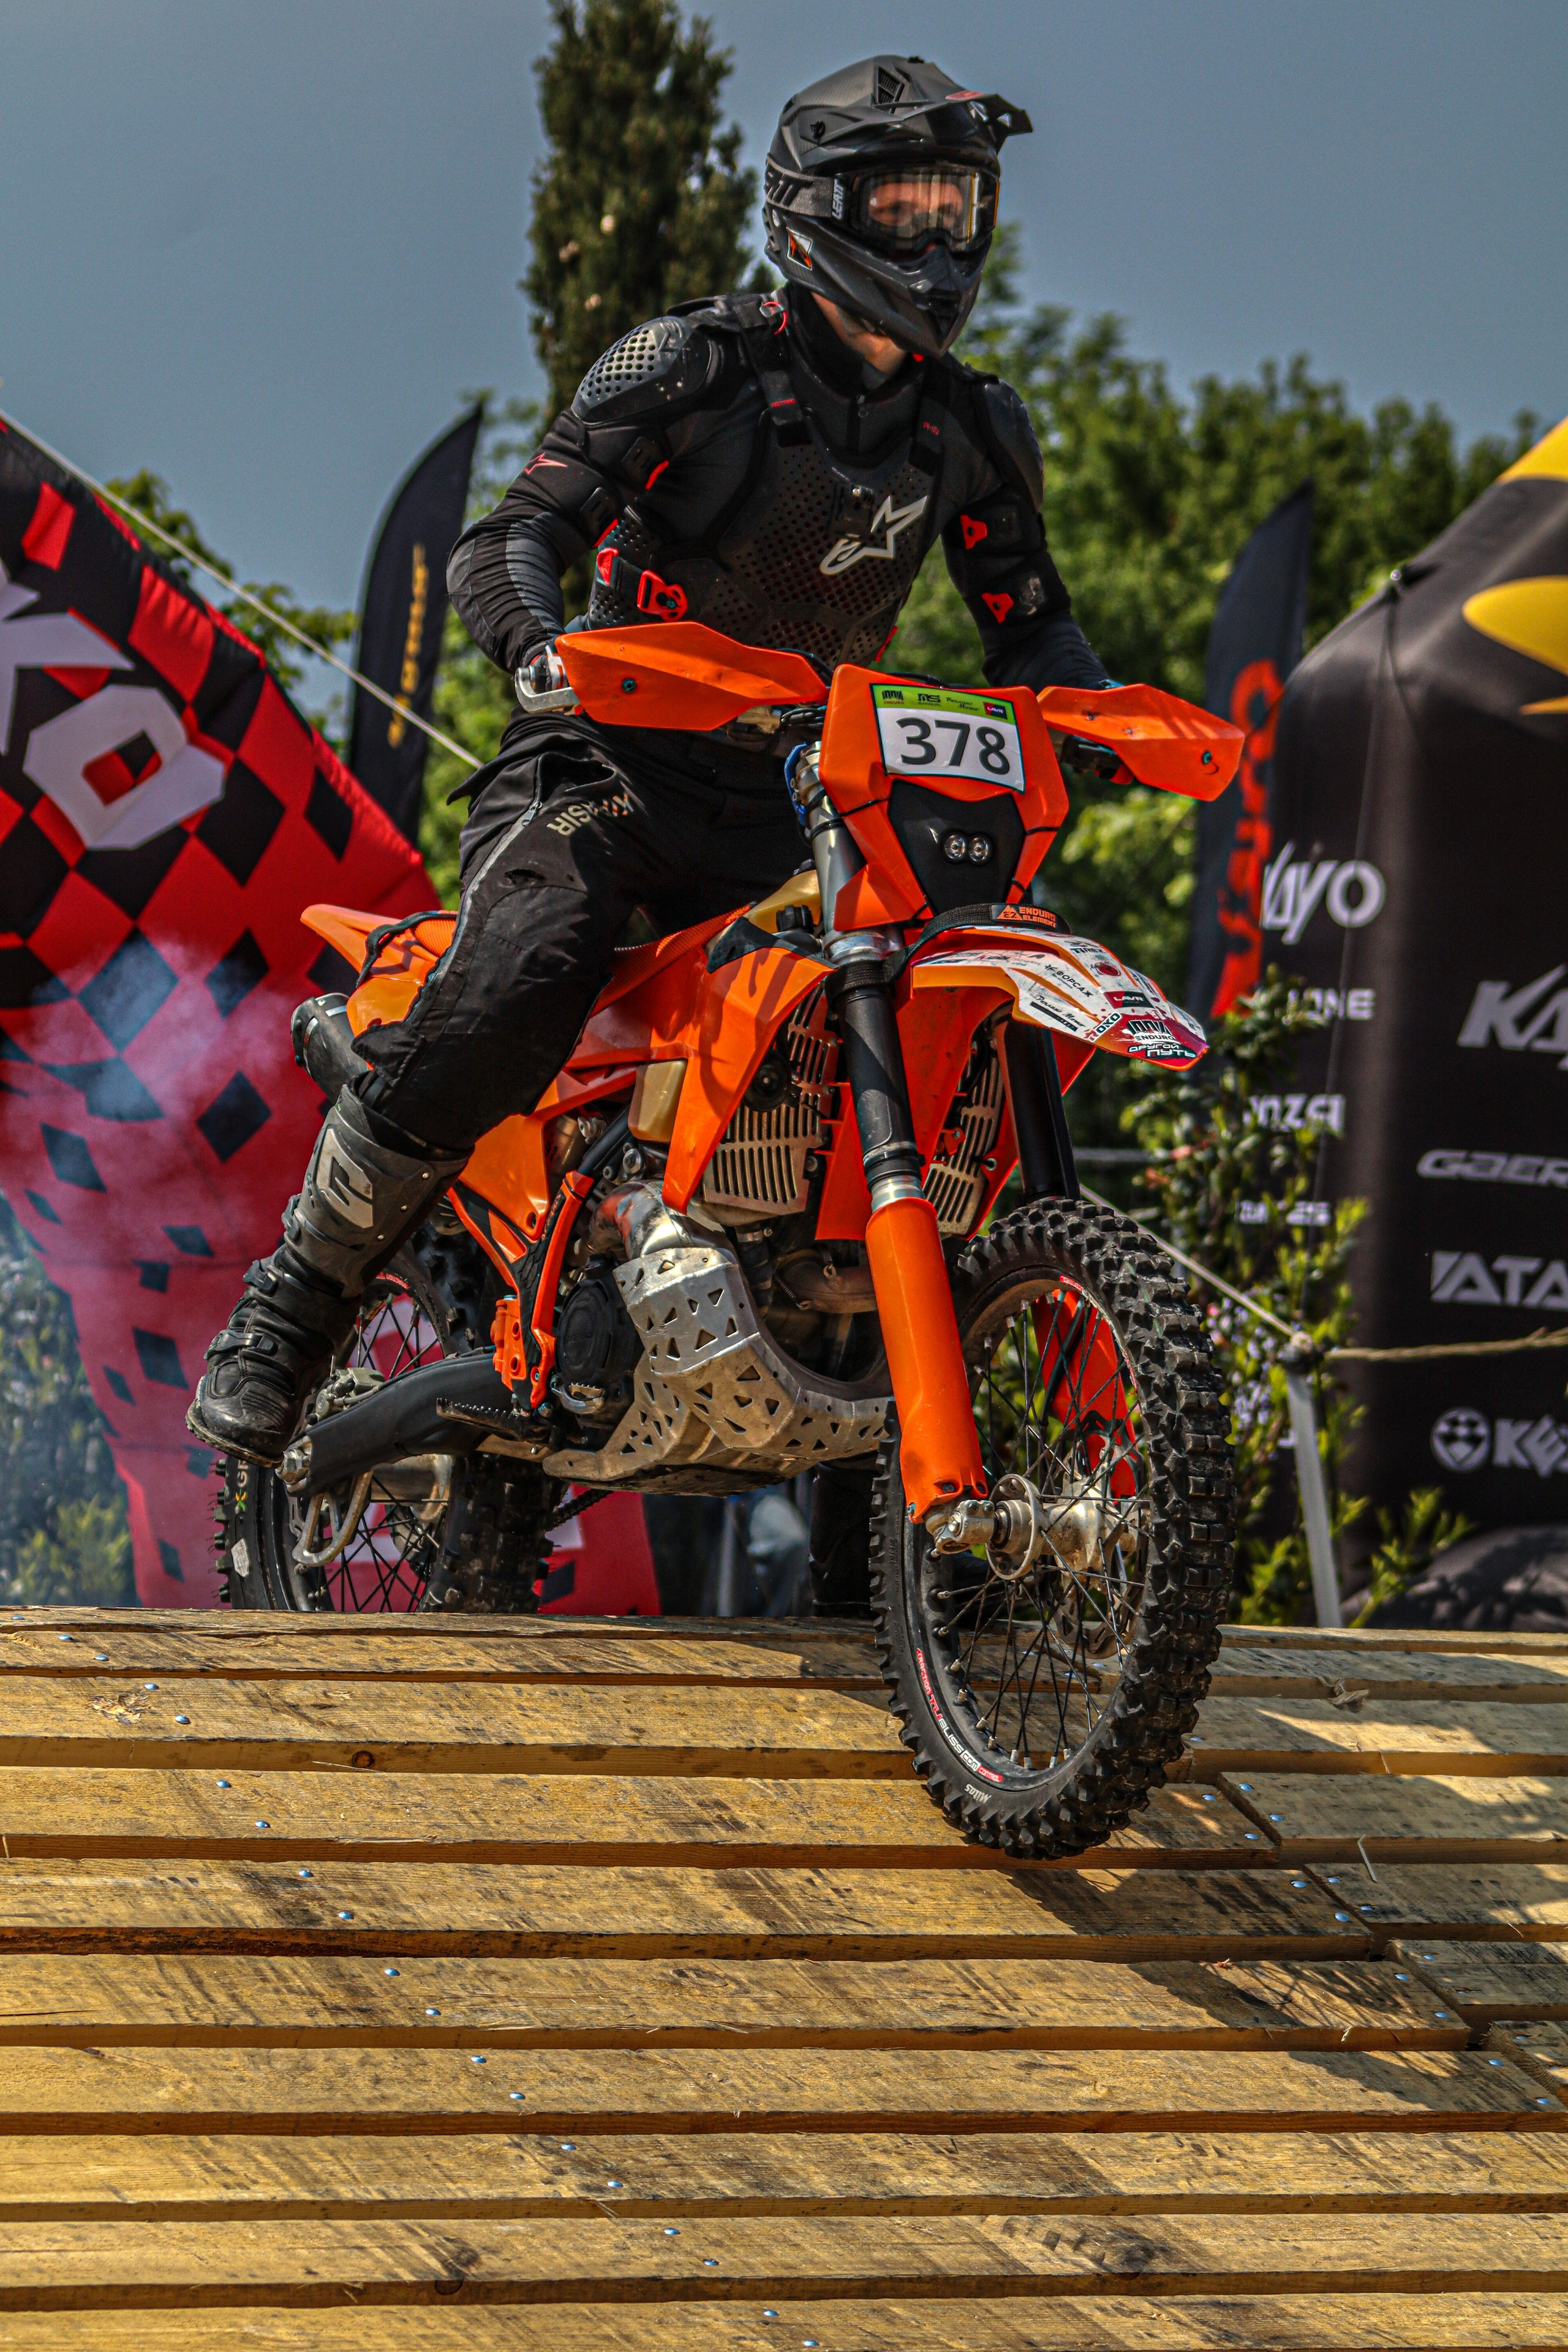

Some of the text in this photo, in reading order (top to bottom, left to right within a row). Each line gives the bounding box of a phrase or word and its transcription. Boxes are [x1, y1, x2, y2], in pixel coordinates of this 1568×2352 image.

[832, 178, 843, 219] LEATT
[895, 717, 1011, 775] 378
[1019, 906, 1057, 922] ENDURO
[1022, 914, 1057, 928] ELEMENT
[1056, 970, 1093, 998] ФОРСАЖ
[1084, 1012, 1121, 1042] ROKO
[1457, 963, 1568, 1071] KA
[1129, 1042, 1180, 1053] ДРУГОЙ
[1147, 1049, 1197, 1058] ПУТЬ
[1493, 1414, 1568, 1477] KE
[918, 1649, 933, 1695] TRACTION
[978, 1766, 1003, 1782] CONTROL
[964, 1783, 992, 1804] Mitas
